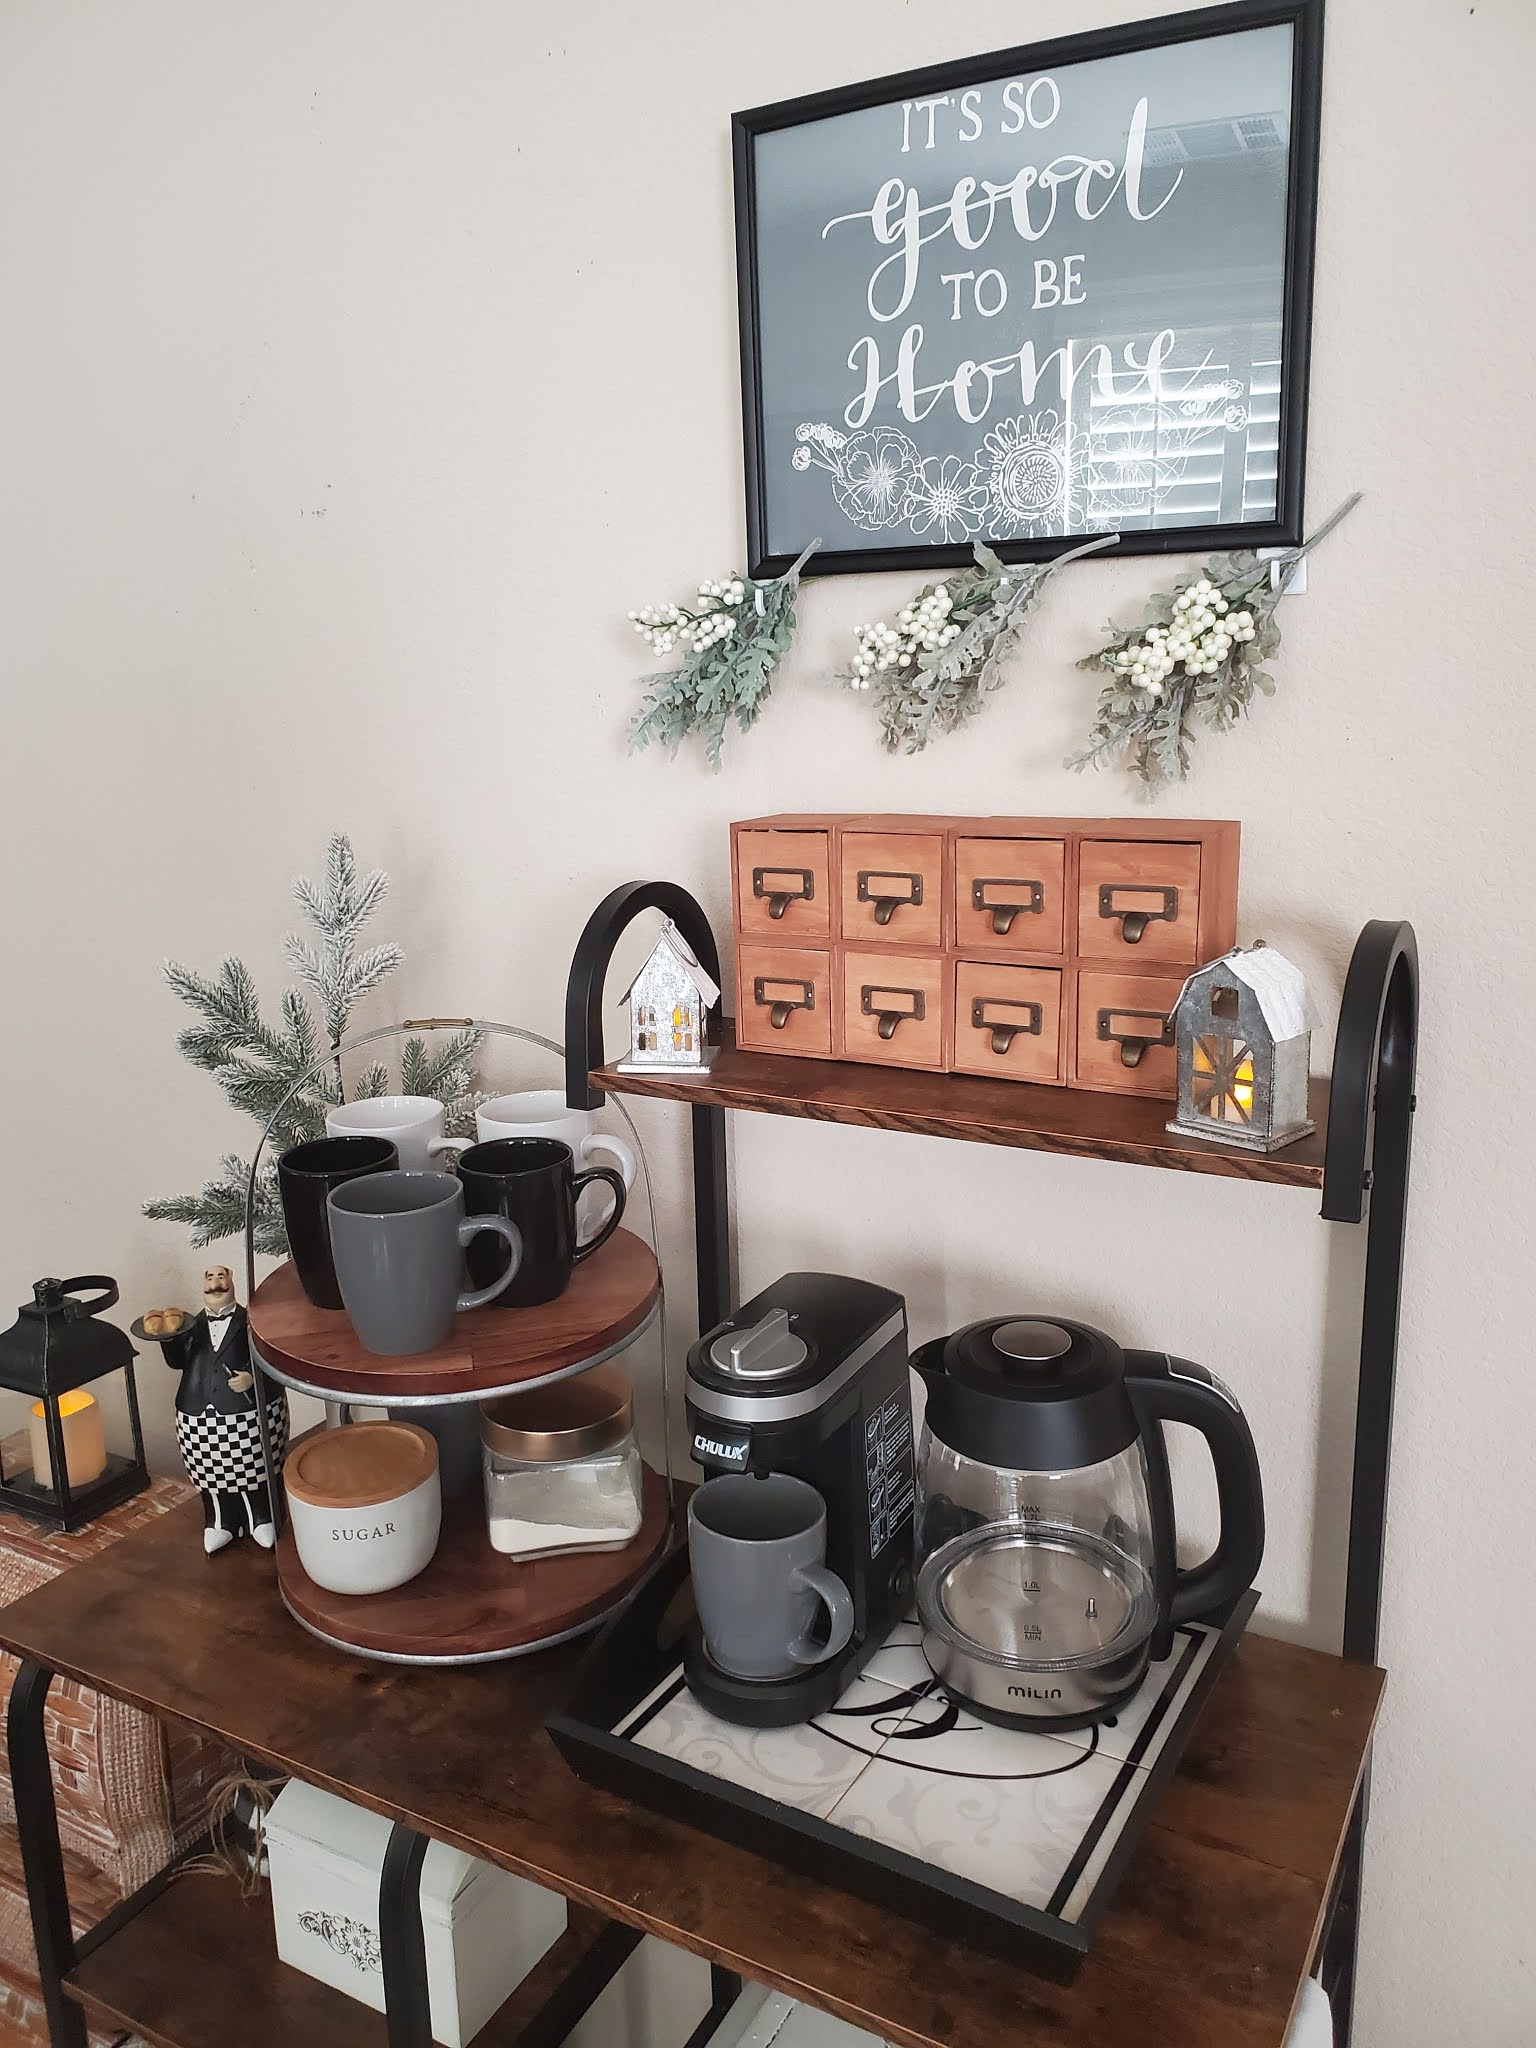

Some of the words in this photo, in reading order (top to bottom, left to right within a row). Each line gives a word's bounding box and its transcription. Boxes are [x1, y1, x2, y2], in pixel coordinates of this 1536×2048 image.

[900, 90, 983, 153] IT'S
[1001, 76, 1061, 135] SO
[821, 96, 1184, 322] good
[940, 270, 1009, 320] TO
[1031, 254, 1087, 310] BE
[843, 323, 1215, 427] Home
[694, 1434, 748, 1461] CHULUX
[1021, 1505, 1041, 1513] MAX
[1023, 1513, 1041, 1521] 1.7L
[332, 1522, 396, 1541] SUGAR
[1024, 1581, 1041, 1589] 1.0L
[1023, 1624, 1041, 1632] 0.5L
[1024, 1633, 1041, 1641] MIN
